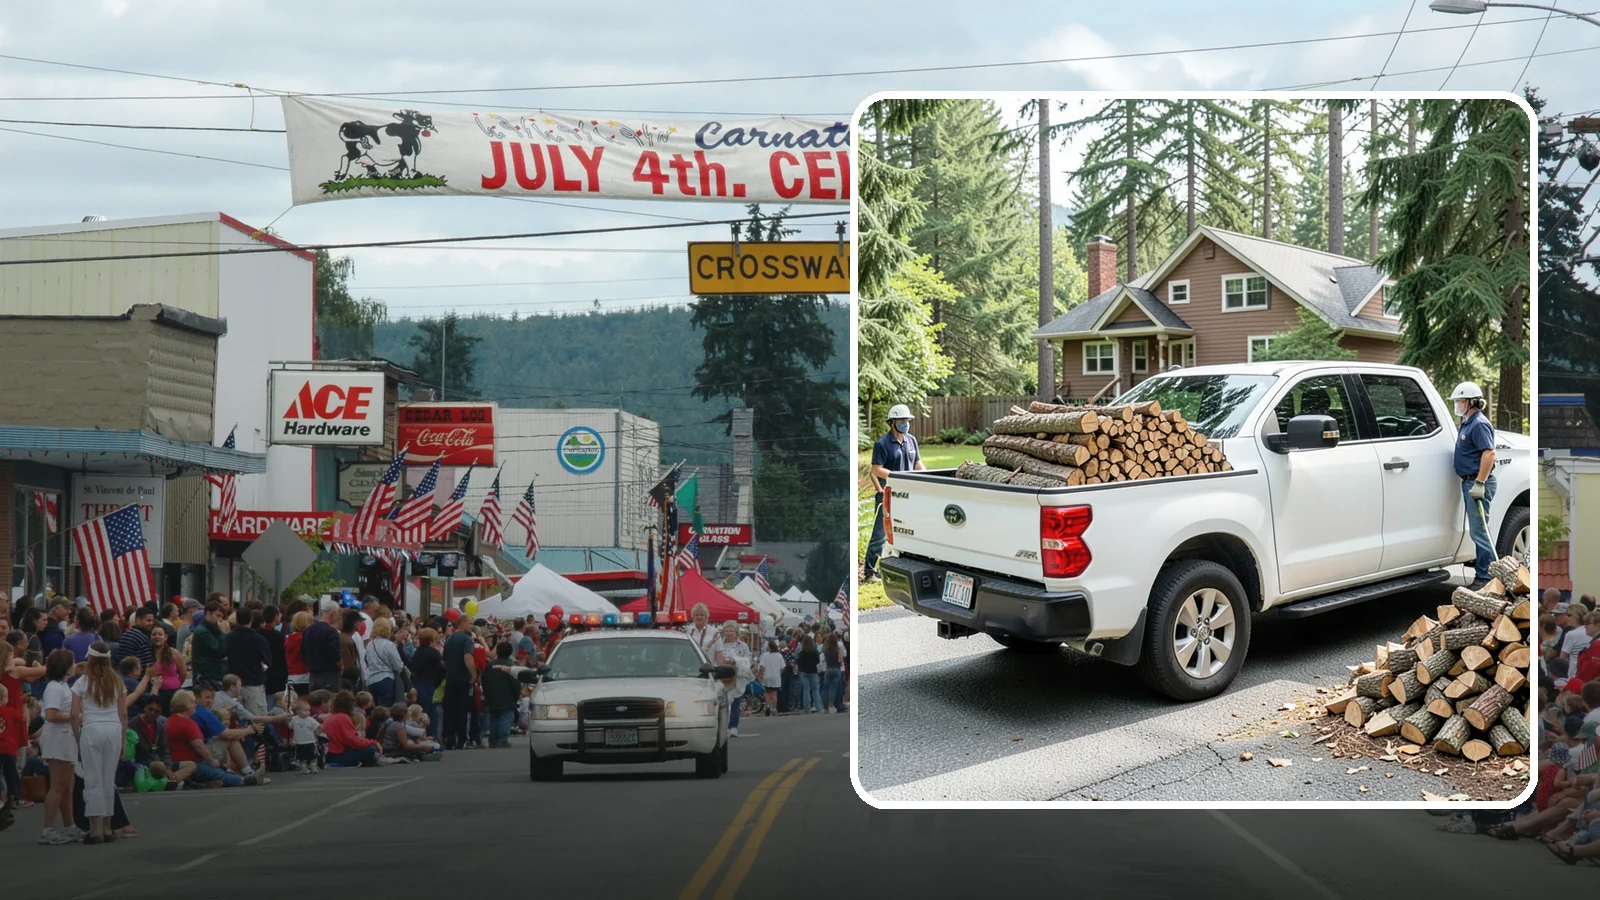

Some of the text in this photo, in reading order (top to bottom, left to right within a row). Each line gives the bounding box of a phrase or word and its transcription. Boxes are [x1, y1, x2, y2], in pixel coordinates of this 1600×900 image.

[695, 121, 850, 150] Carnat
[481, 140, 605, 192] JULY
[632, 150, 747, 198] 4th.
[697, 254, 850, 280] CROSSWA
[283, 380, 373, 420] ACE
[405, 409, 452, 422] CEDAR
[283, 421, 371, 436] Hardware
[416, 427, 477, 447] Coca-Cola
[353, 467, 386, 482] Simpl
[83, 485, 155, 495] St. Vincent de Paul
[699, 535, 730, 543] GLASS
